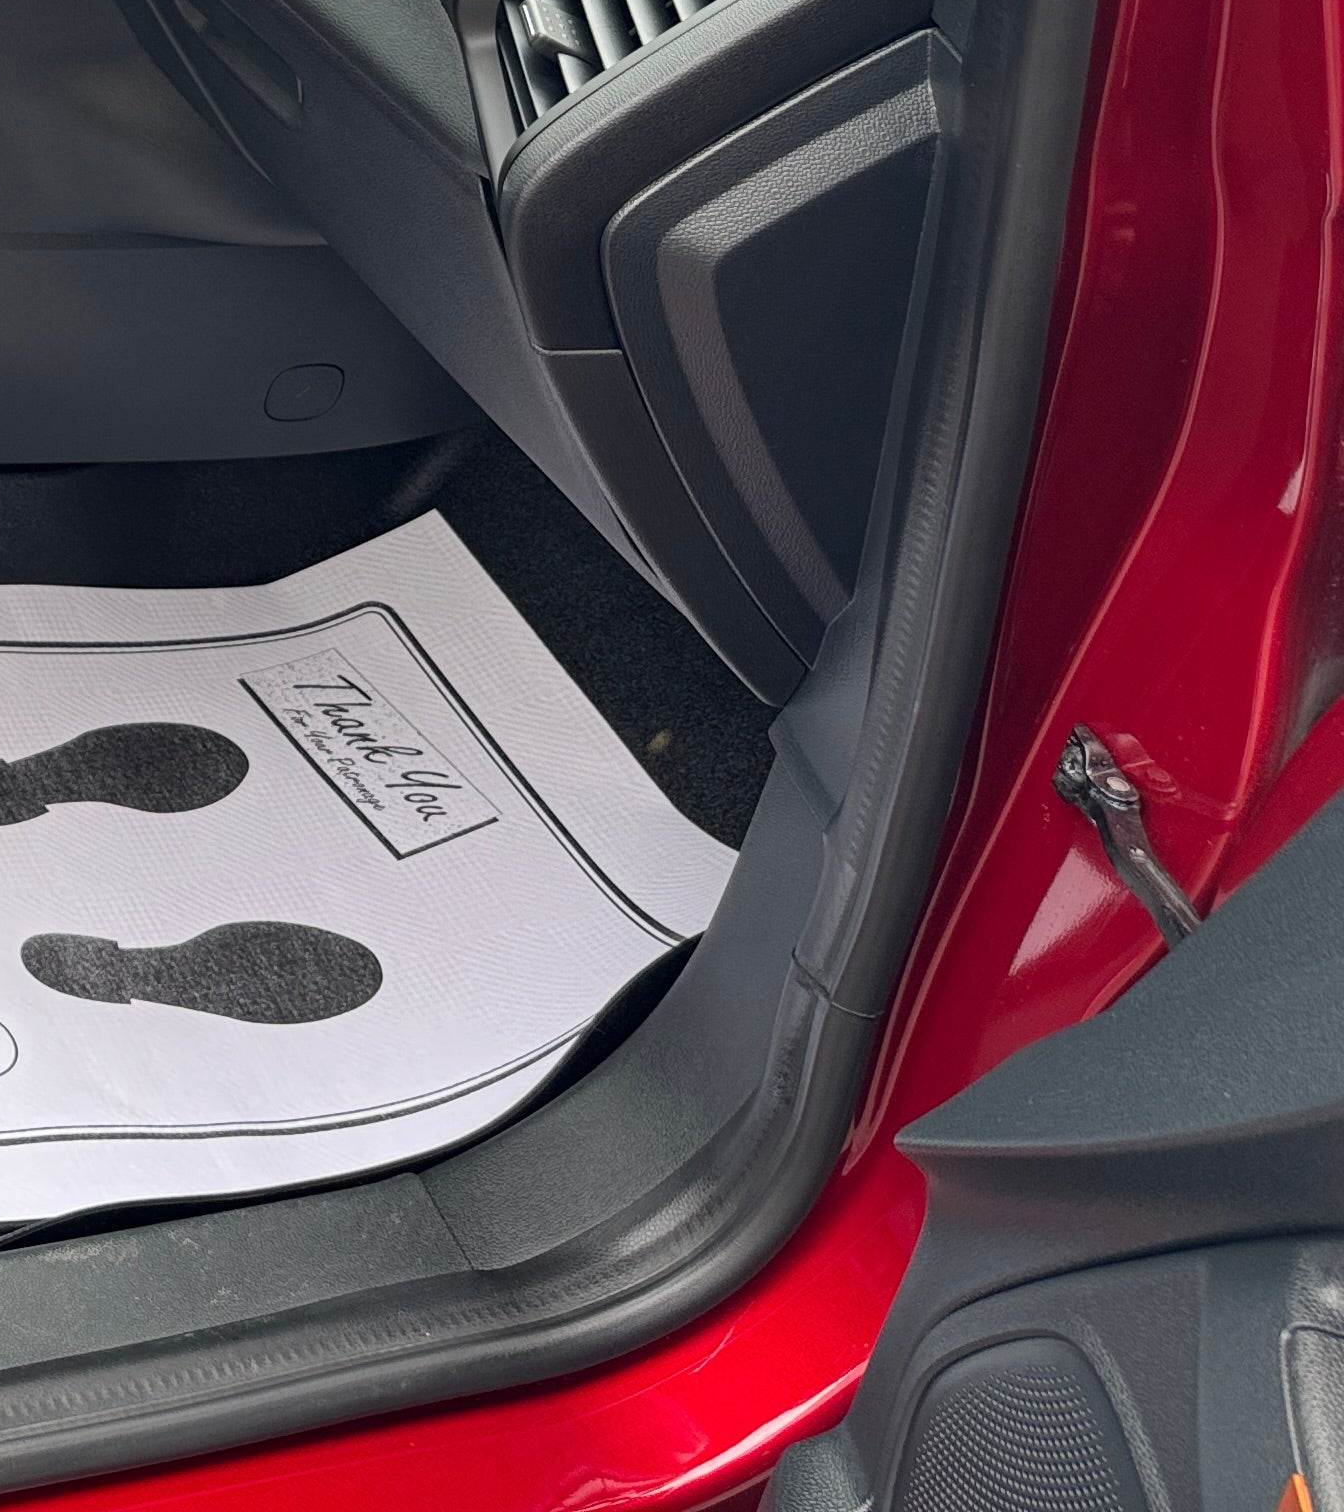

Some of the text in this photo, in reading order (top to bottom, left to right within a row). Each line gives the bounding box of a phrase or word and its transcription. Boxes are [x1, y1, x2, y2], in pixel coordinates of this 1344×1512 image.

[282, 707, 385, 811] For Your Patronage
[293, 674, 463, 822] Thank You
